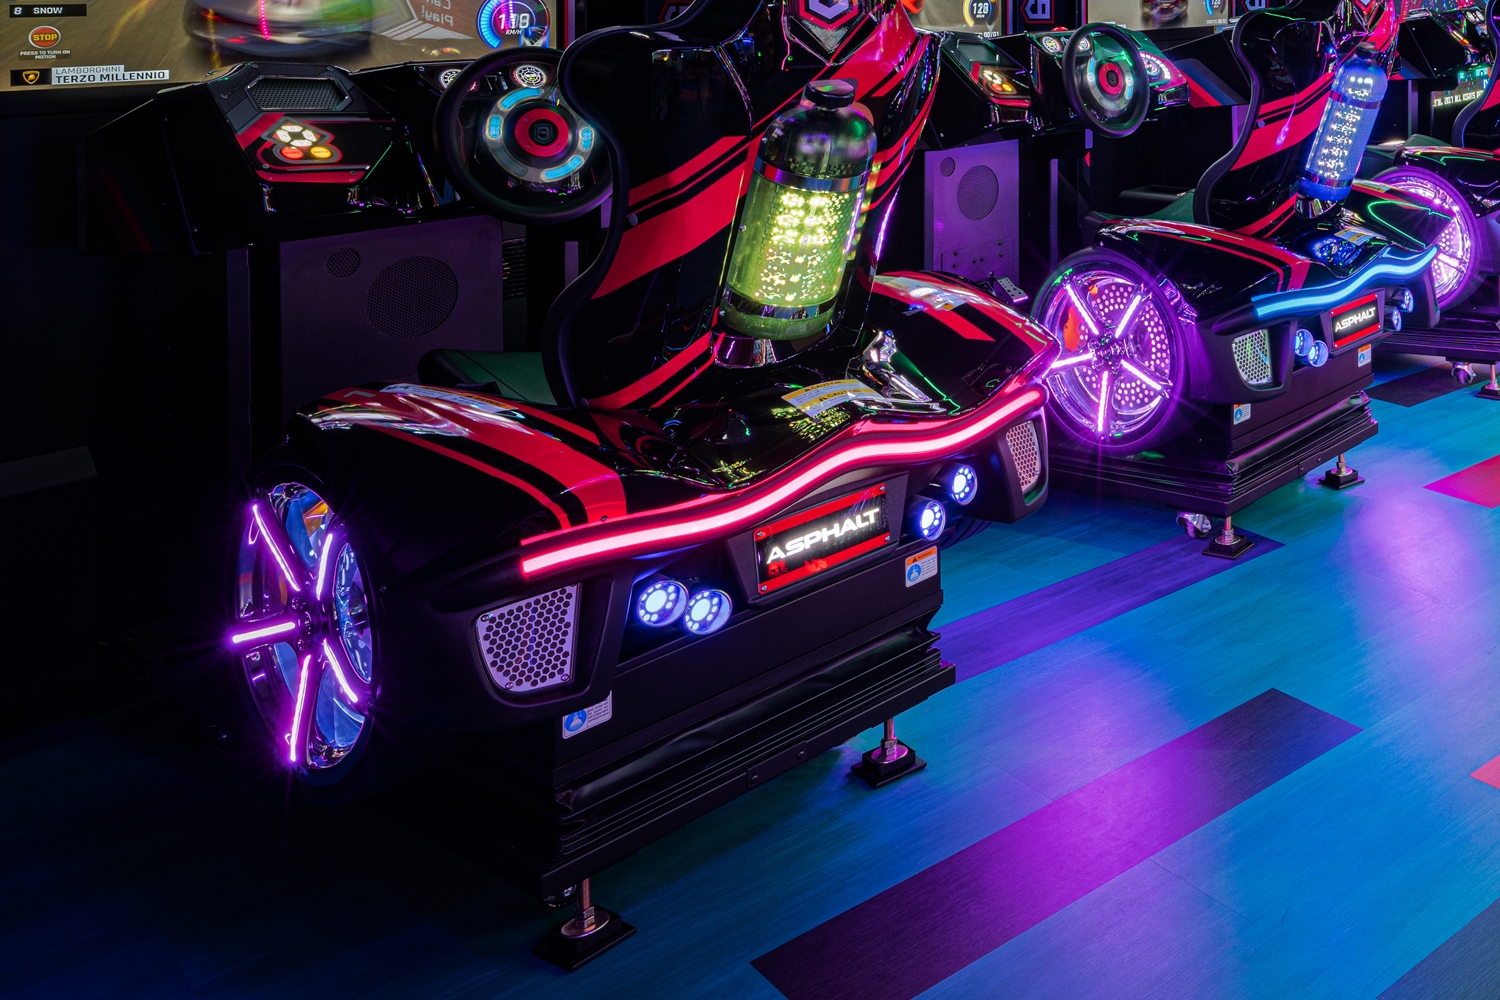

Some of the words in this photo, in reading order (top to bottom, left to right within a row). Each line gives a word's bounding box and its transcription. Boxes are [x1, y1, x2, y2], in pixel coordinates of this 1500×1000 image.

[14, 6, 22, 15] 8
[33, 6, 63, 15] SNOW
[1025, 0, 1051, 19] 9
[33, 33, 58, 42] STOP
[56, 66, 121, 75] LAMBORGHINI
[56, 74, 96, 84] TERZO
[100, 71, 166, 82] MILLENNIO
[1334, 306, 1376, 333] ASPHALT
[766, 507, 881, 564] ASPHALT
